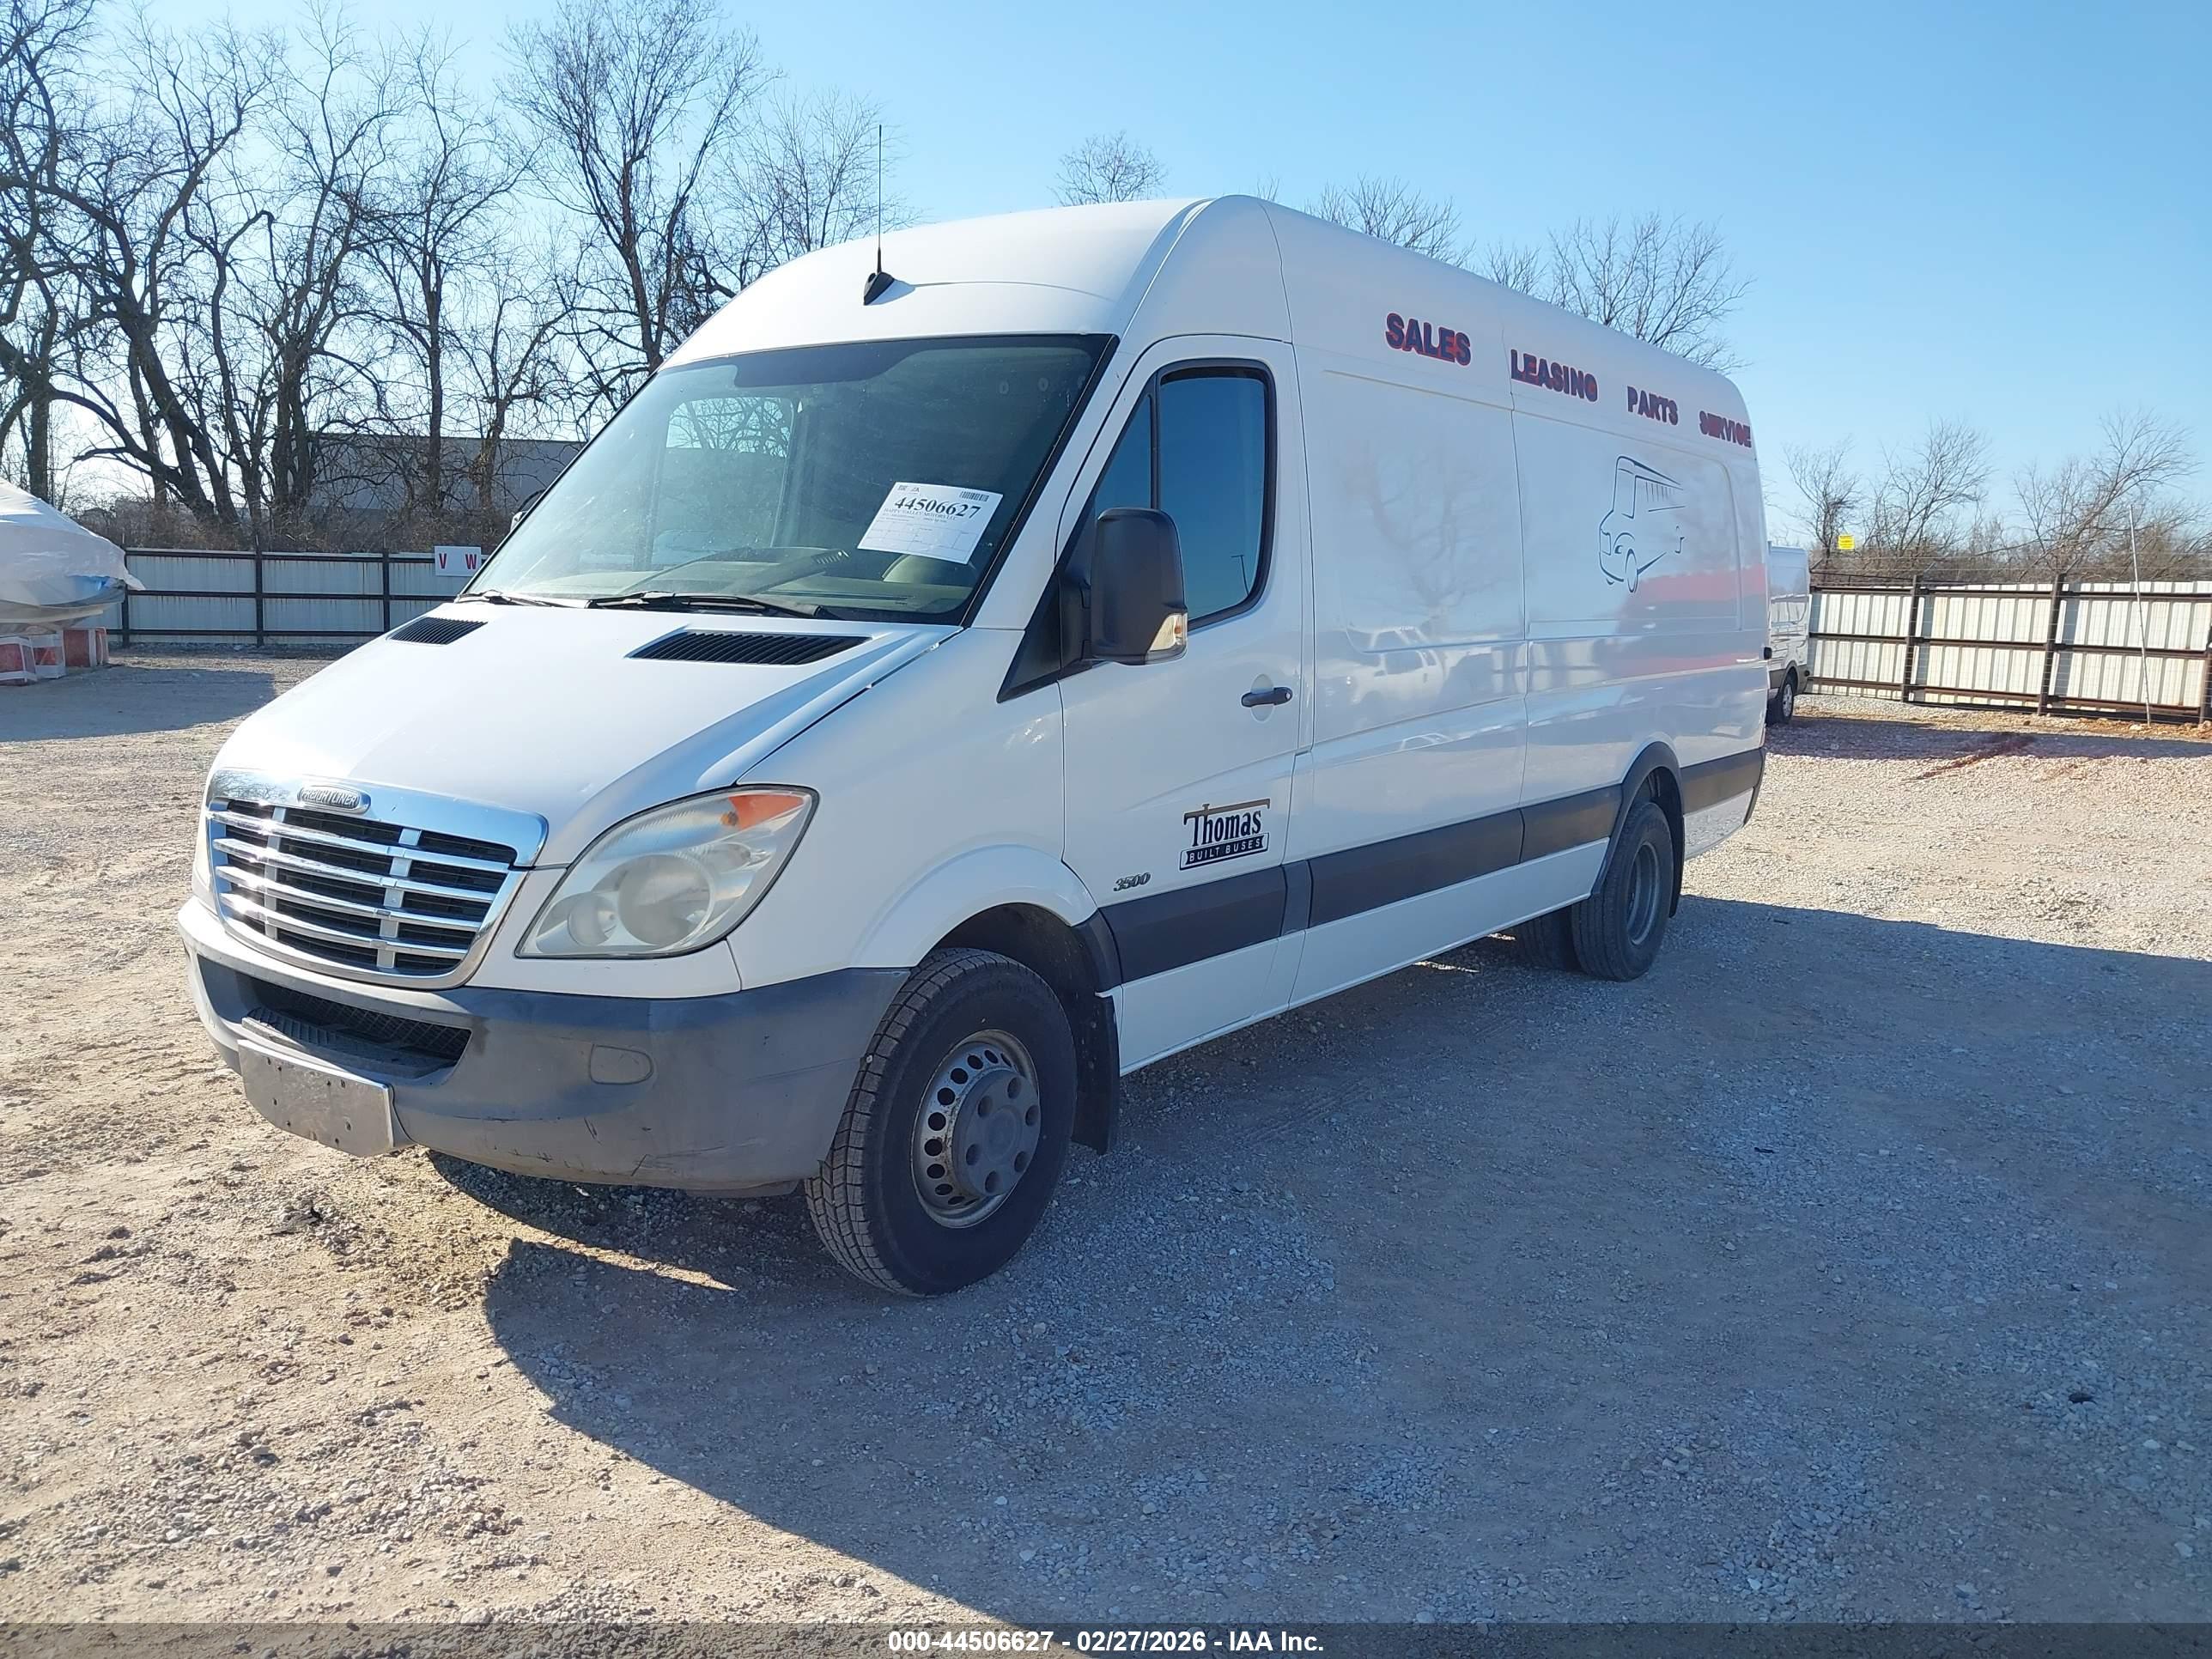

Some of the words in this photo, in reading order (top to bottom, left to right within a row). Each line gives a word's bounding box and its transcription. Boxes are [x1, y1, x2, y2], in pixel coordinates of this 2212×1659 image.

[1385, 313, 1471, 366] SALES
[1510, 349, 1598, 402] LEASING
[1627, 386, 1678, 426] PARTS
[895, 496, 981, 519] 44506627
[439, 553, 447, 569] V
[465, 554, 477, 569] W
[301, 789, 358, 806] FREIGHTLINER
[1183, 799, 1270, 847] Thomas
[1189, 848, 1220, 862] BUILT
[1225, 838, 1261, 854] BUSES
[1114, 872, 1151, 891] 3500
